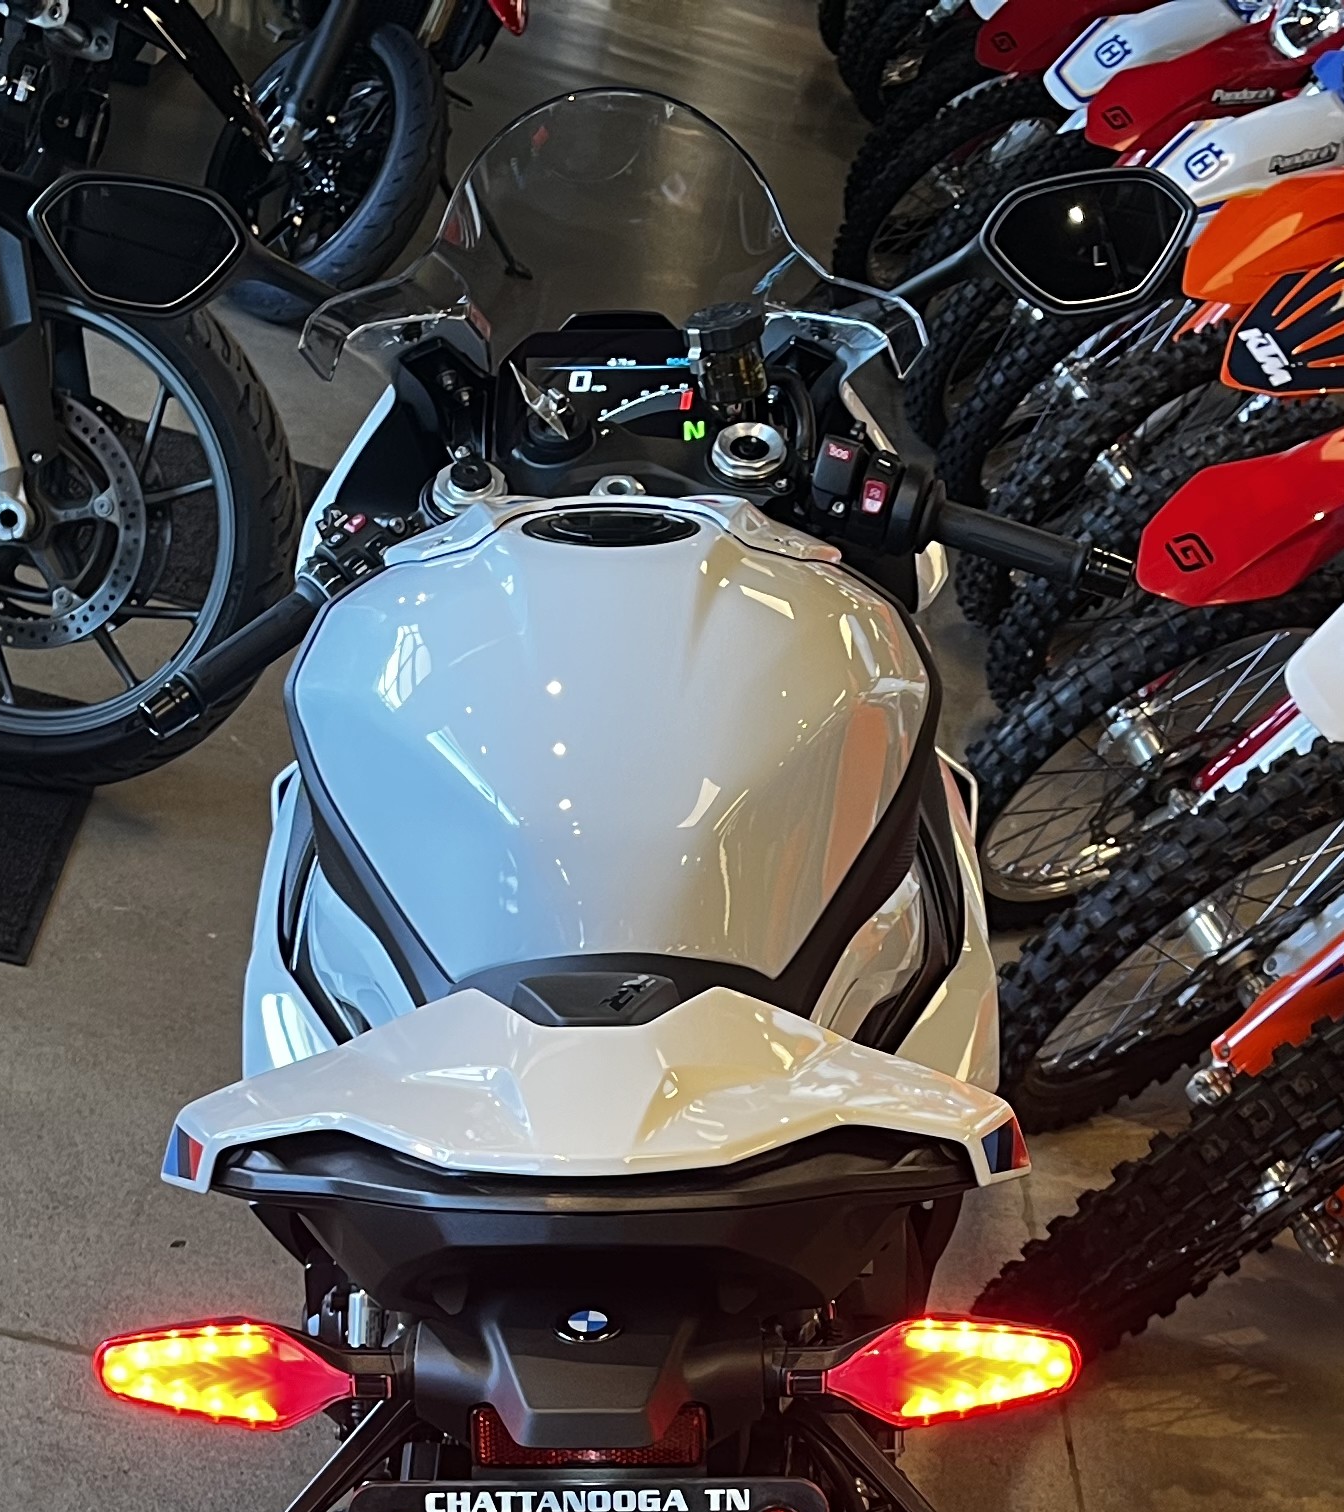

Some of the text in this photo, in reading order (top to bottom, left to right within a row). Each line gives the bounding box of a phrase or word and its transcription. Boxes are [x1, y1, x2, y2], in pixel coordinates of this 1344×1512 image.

[1238, 327, 1292, 387] KTM
[568, 371, 593, 393] 0
[683, 420, 705, 441] N
[704, 1488, 750, 1512] TN
